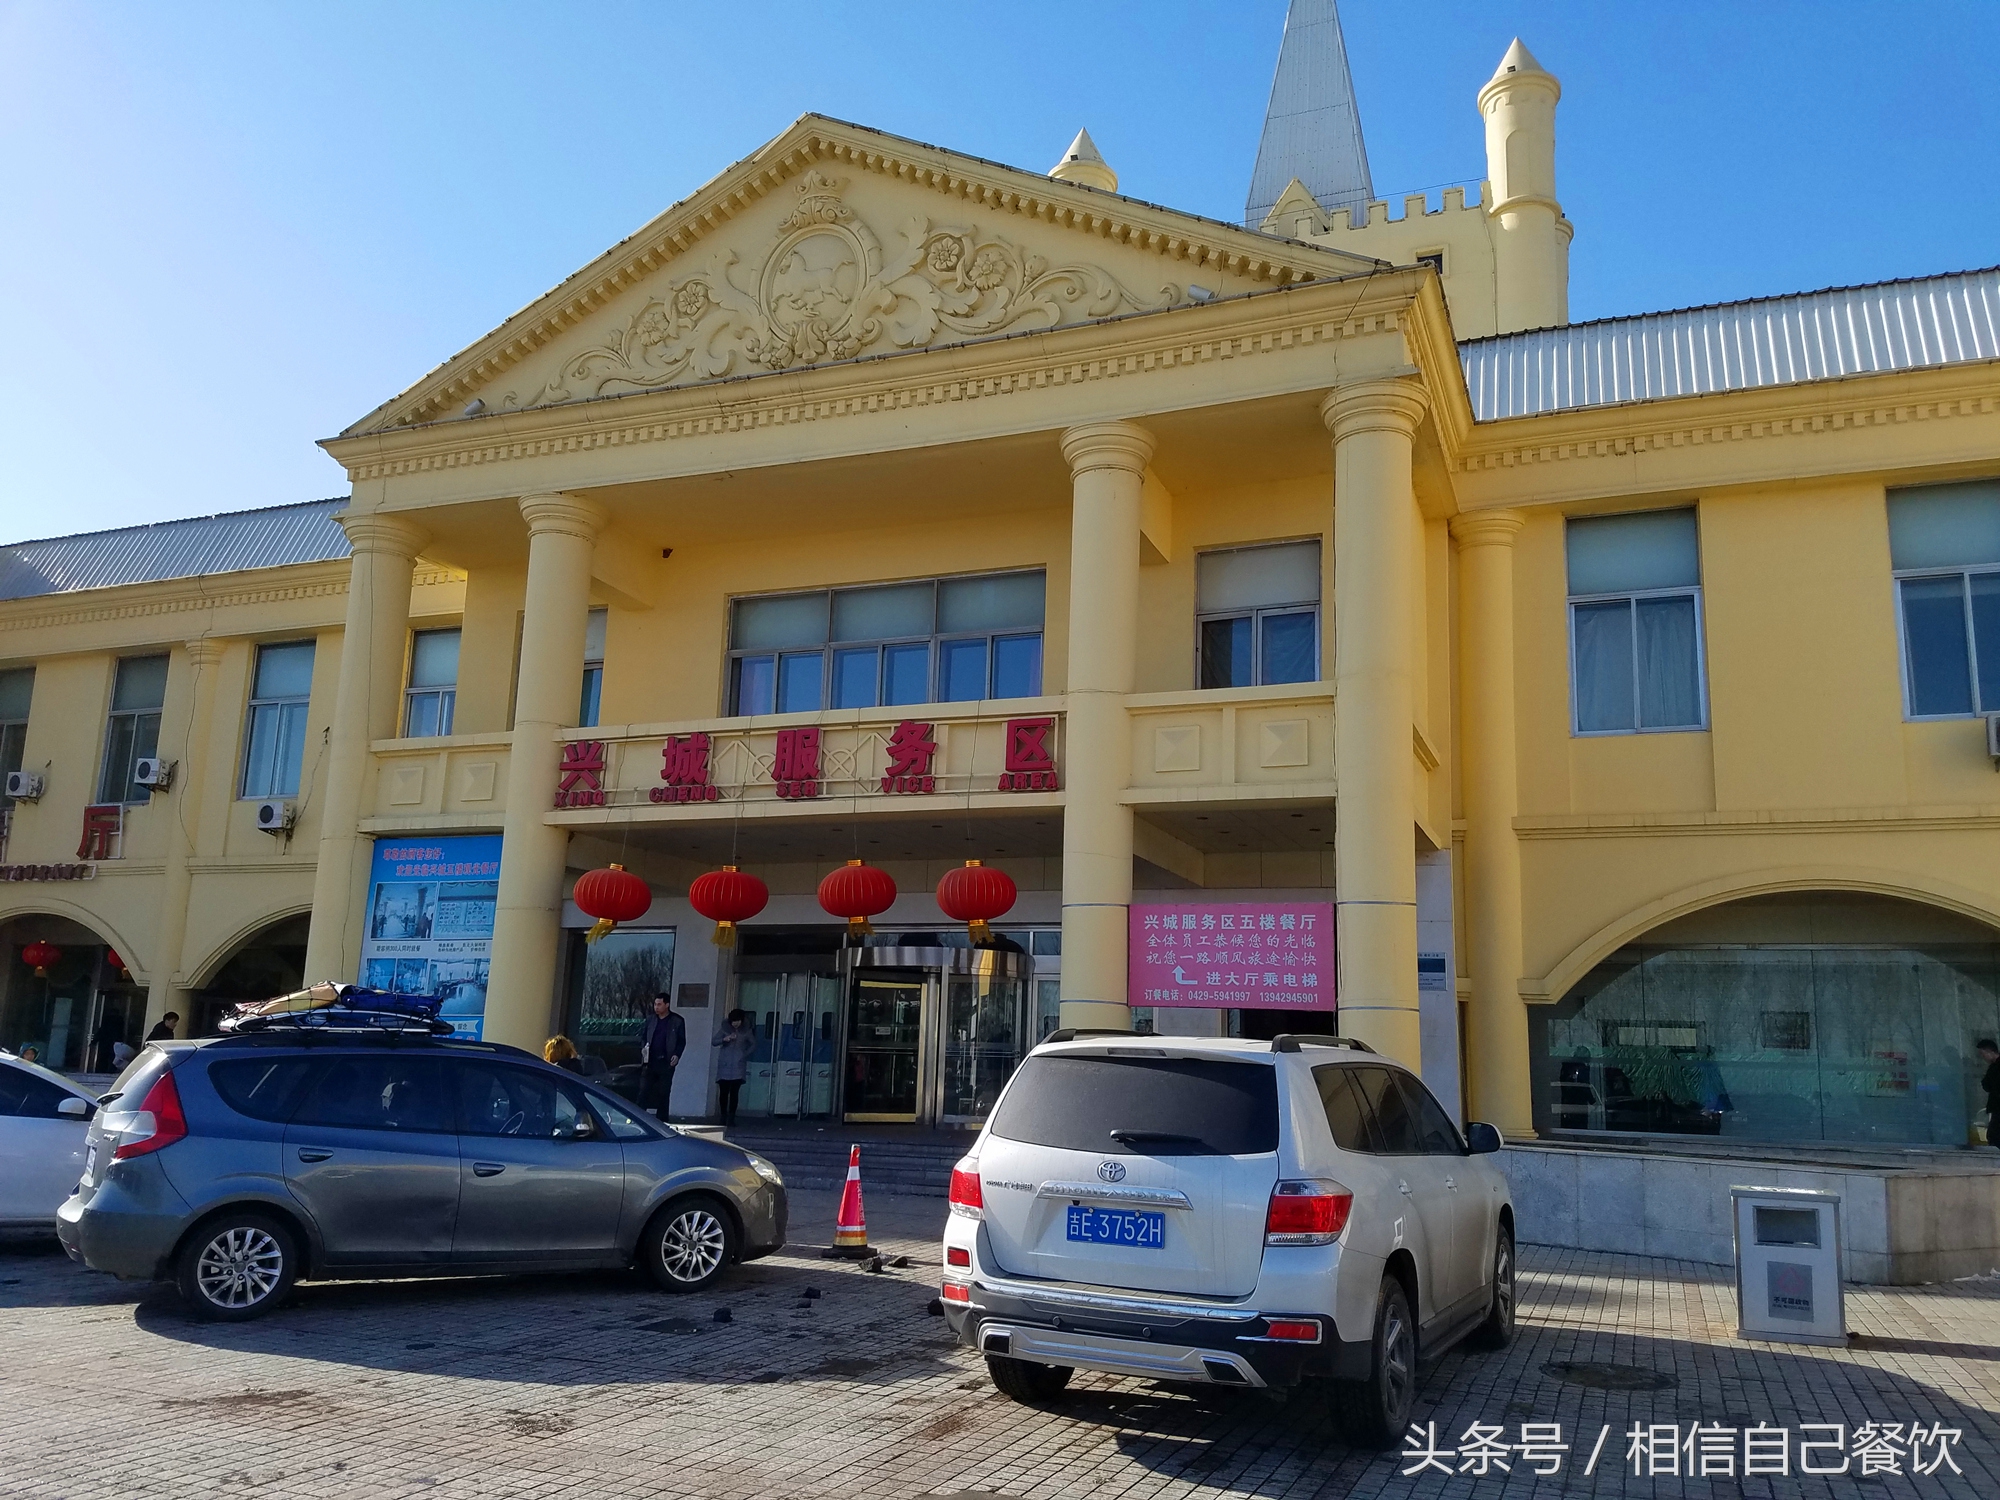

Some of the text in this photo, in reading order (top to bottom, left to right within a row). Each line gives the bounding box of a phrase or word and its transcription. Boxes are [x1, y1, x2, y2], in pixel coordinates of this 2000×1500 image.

[559, 718, 1055, 791] 兴城服务区
[553, 771, 1058, 807] XING CHENG SER VICE AREA
[1144, 913, 1317, 931] 兴城服务区五楼餐厅
[1145, 933, 1316, 949] 全体员工恭候您的光临
[1145, 951, 1317, 967] 祝您一路顺风旅途愉快
[1206, 972, 1318, 988] 进大厅乘电梯
[1260, 992, 1319, 1004] 13942945901
